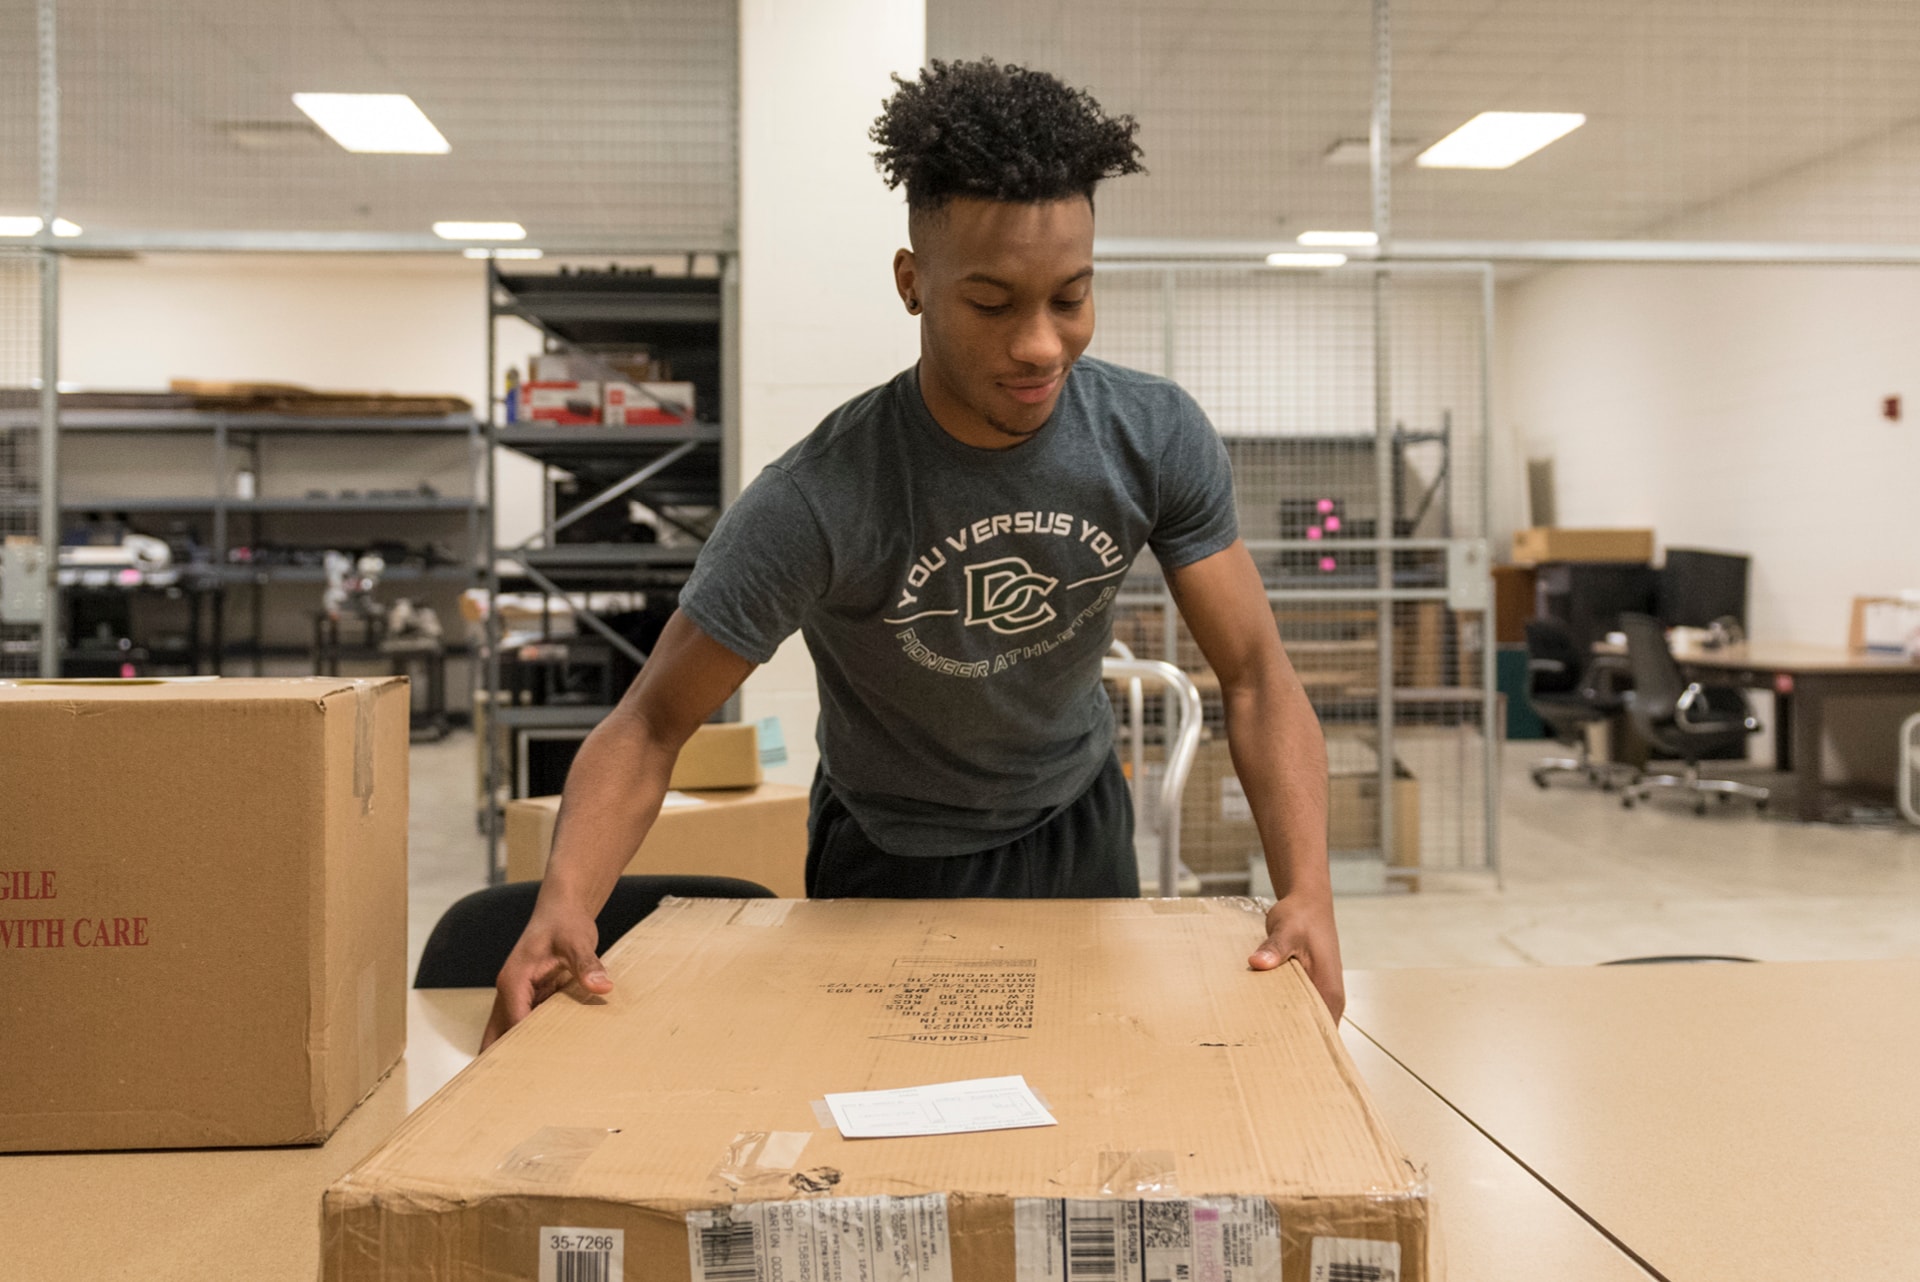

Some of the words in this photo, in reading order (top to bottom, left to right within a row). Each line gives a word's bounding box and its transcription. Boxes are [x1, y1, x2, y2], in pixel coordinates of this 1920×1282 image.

[897, 546, 947, 609] YOU
[945, 511, 1074, 551] VERSUS
[1078, 519, 1124, 568] YOU
[896, 627, 990, 678] PIONEER
[992, 585, 1116, 674] ATHLETICS
[73, 917, 149, 948] CARE
[551, 1234, 613, 1250] 35-7266
[768, 1206, 781, 1248] CARTON
[1127, 1223, 1138, 1264] GROUND
